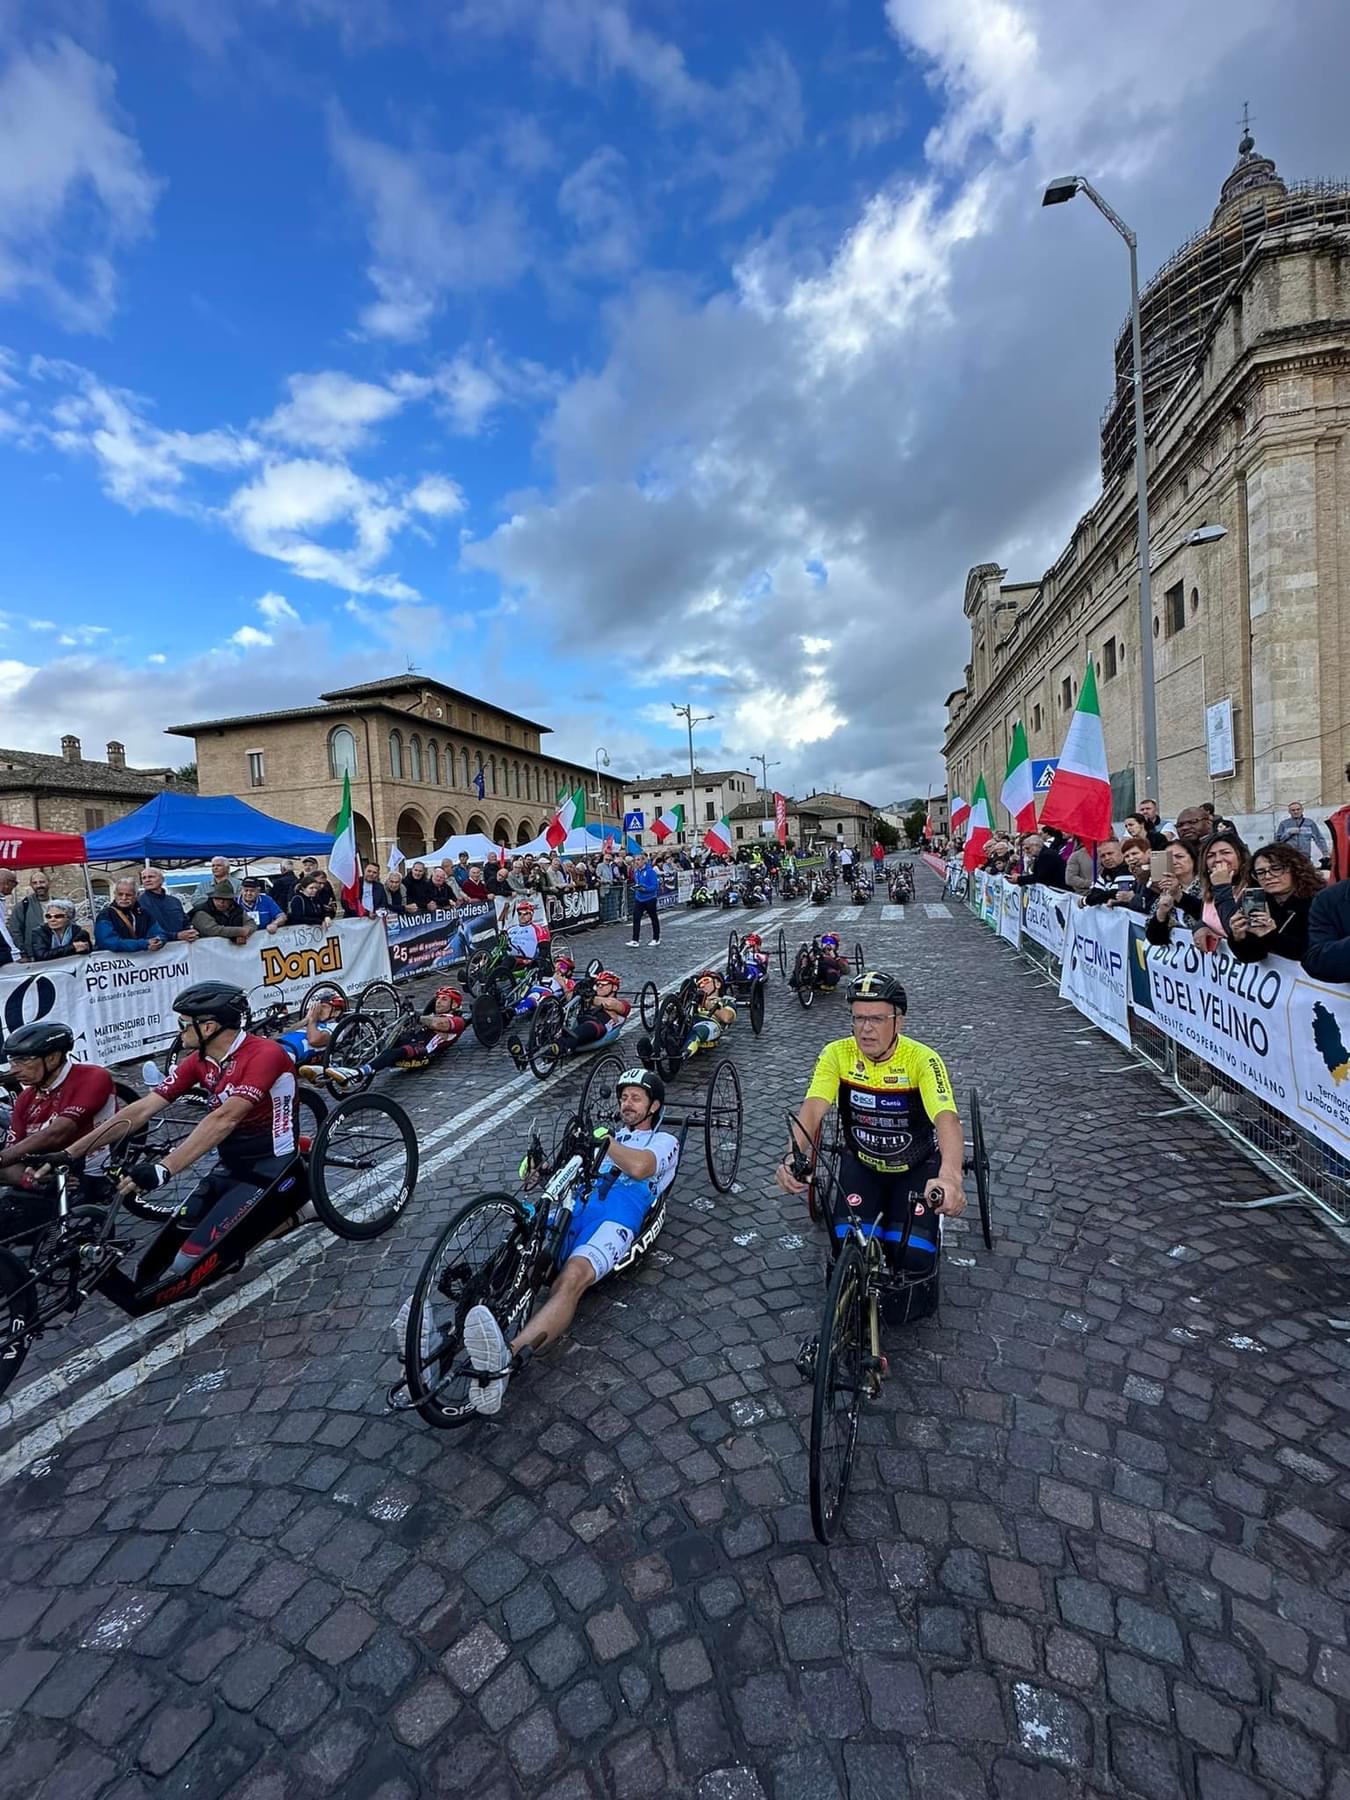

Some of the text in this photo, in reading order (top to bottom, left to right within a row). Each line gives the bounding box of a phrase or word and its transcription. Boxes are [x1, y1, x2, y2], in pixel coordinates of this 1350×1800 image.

[399, 912, 432, 929] Nuova
[293, 926, 324, 946] 1850
[260, 935, 343, 986] Dondi
[393, 944, 408, 962] 25
[85, 959, 136, 974] AGENZIA
[86, 962, 189, 992] PC INFORTUNI
[1211, 952, 1282, 1010] SPELLO
[94, 1013, 161, 1038] MARTINSICURO (TE)
[1153, 971, 1162, 999] E
[1163, 975, 1197, 1016] DEL
[1199, 988, 1269, 1057] VELINO
[1156, 1010, 1286, 1099] CREDITO COOPERATIVO ITALIANO
[1305, 1090, 1333, 1114] Umbro
